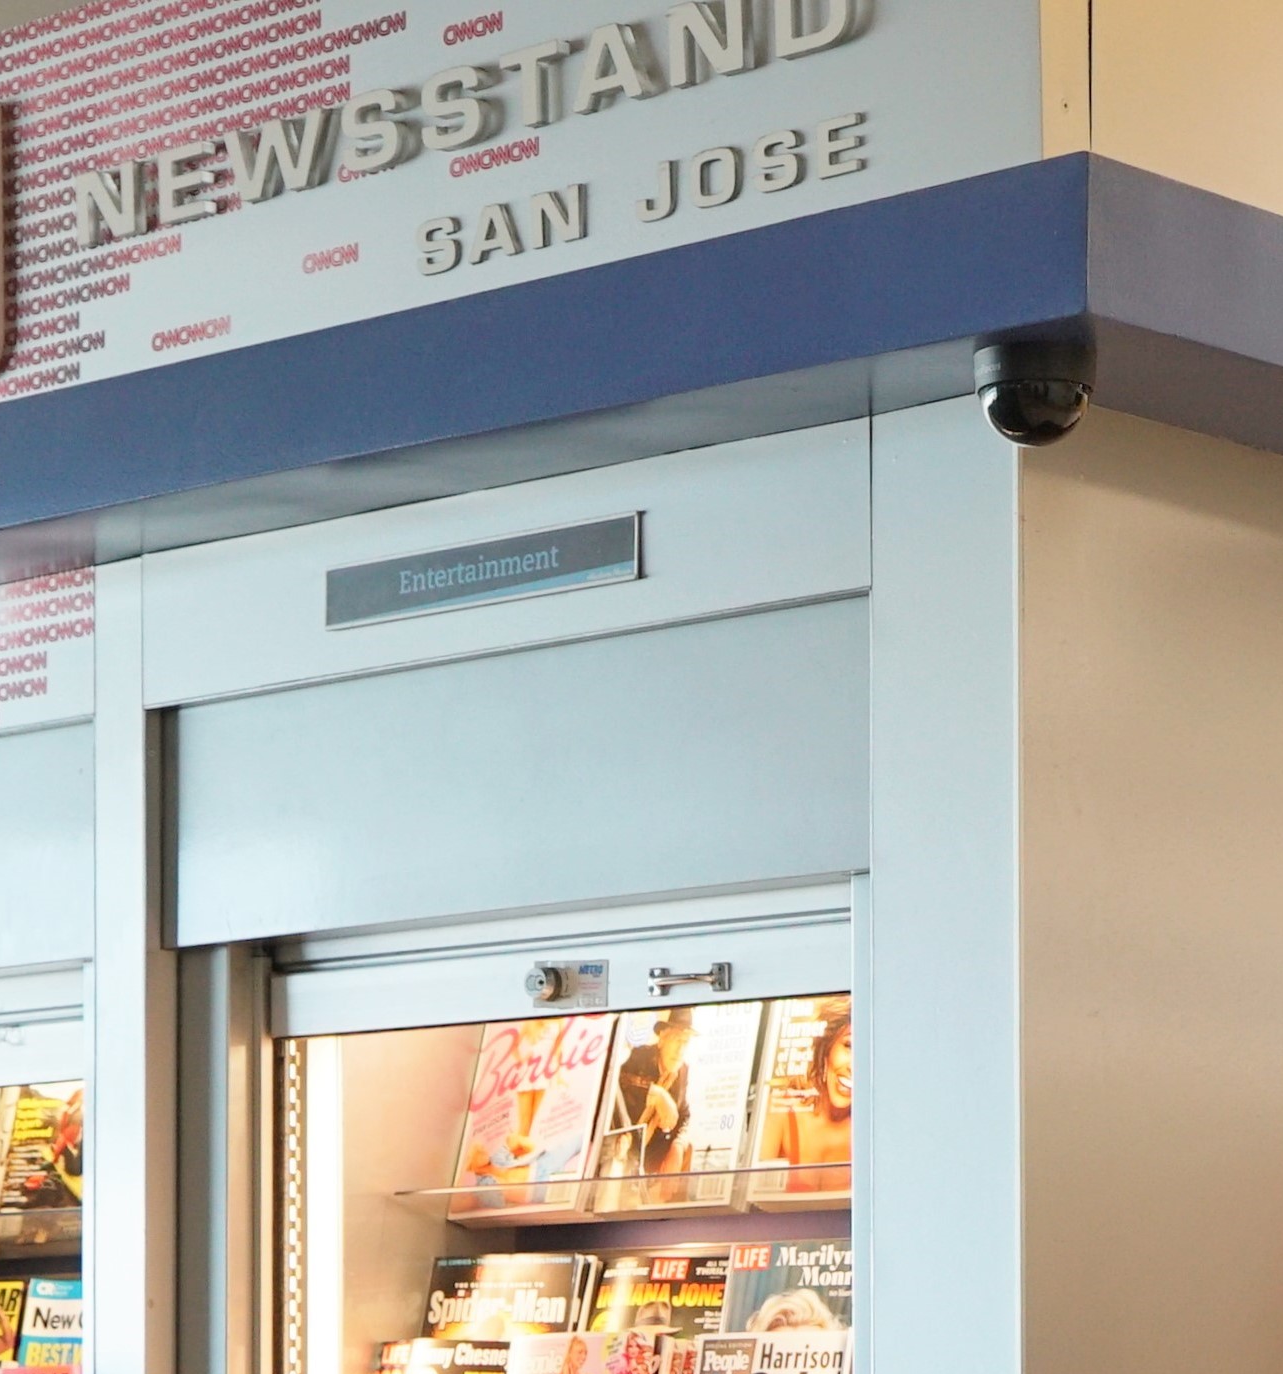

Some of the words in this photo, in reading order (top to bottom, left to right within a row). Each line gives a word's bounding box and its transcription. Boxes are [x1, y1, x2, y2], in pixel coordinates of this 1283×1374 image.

[75, 0, 861, 249] NEWSSTAND
[416, 183, 590, 277] SAN
[635, 111, 869, 224] JOSE
[398, 545, 560, 595] Entertainment
[469, 1016, 604, 1113] Barbie
[652, 1258, 689, 1280] LIFE
[734, 1247, 771, 1270] LIFE
[32, 1308, 75, 1330] New
[427, 1288, 568, 1330] Spider-Man
[759, 1342, 843, 1370] Harrison
